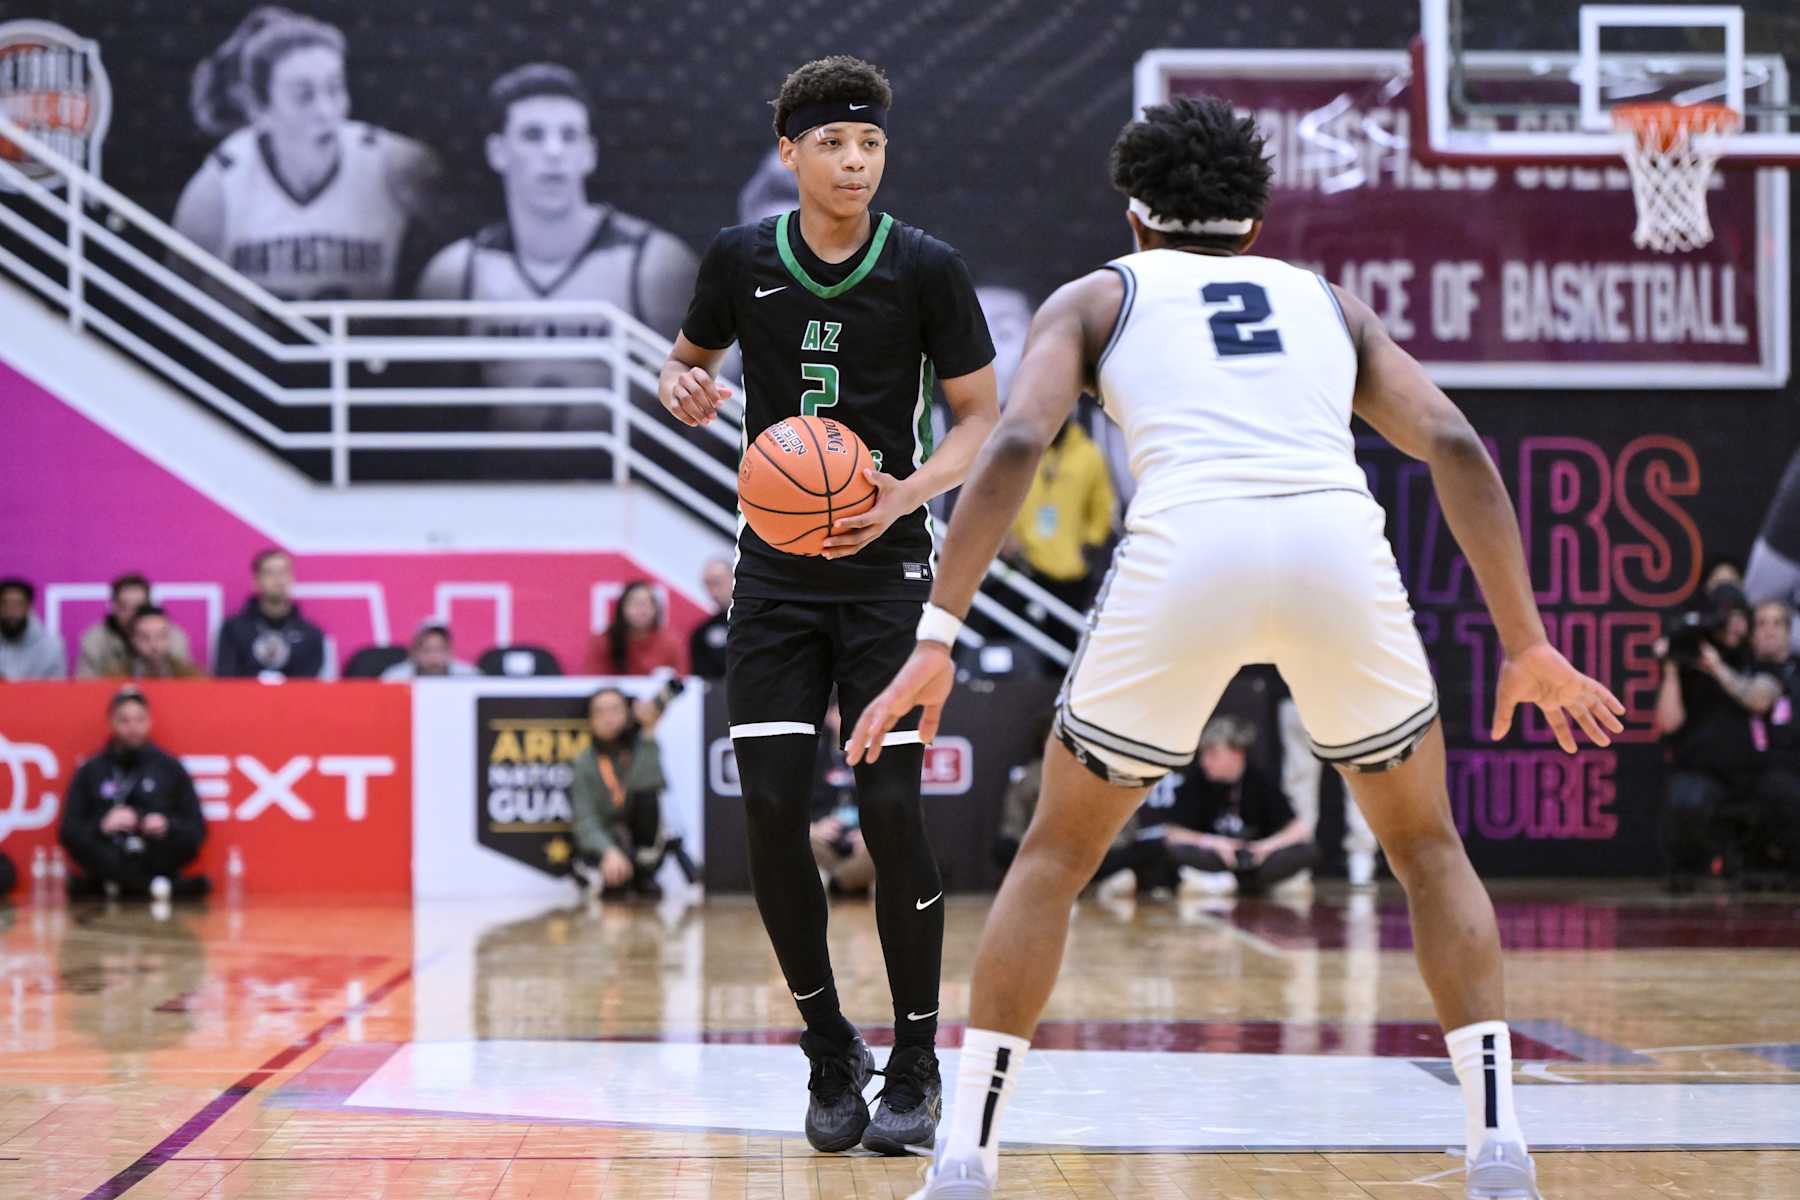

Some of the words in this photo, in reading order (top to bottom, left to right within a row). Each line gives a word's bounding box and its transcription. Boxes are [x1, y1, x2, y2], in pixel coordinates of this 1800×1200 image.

[801, 320, 842, 352] AZ
[1201, 281, 1285, 357] 2
[1431, 261, 1484, 341] OF
[1503, 262, 1748, 344] BASKETBALL
[801, 363, 840, 417] 2
[181, 754, 396, 822] EXT
